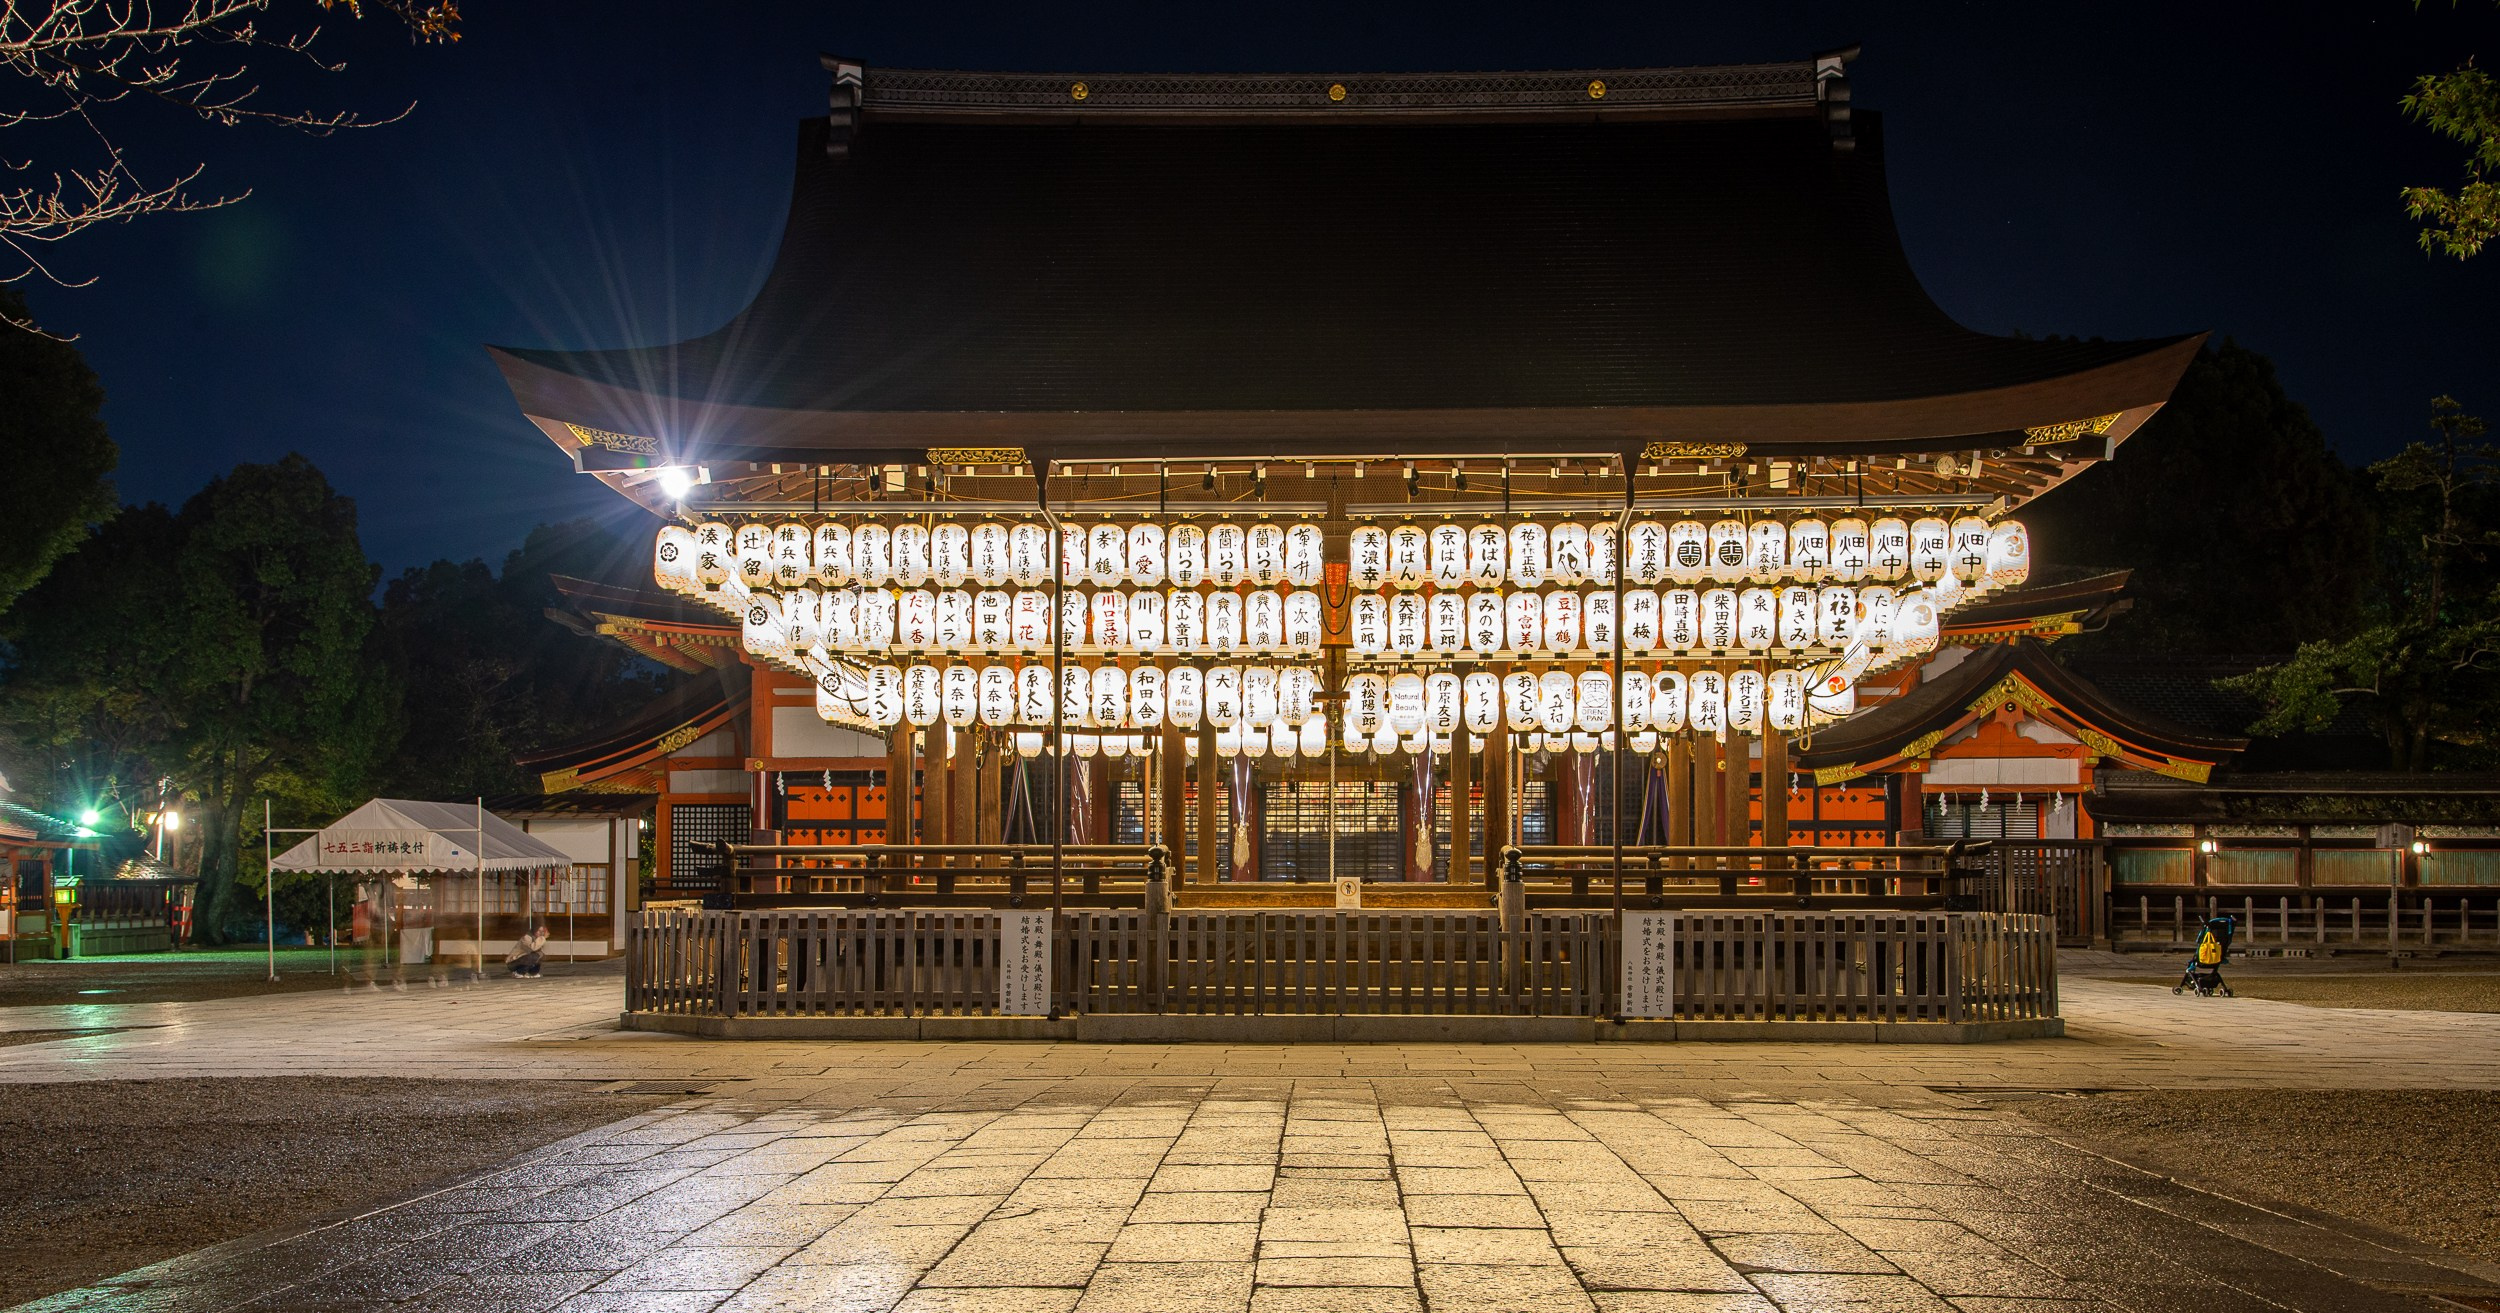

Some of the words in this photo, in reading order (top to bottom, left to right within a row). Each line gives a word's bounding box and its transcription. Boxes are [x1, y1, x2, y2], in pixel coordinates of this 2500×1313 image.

[700, 528, 719, 570] 湊家
[743, 533, 761, 577] 辻留
[779, 527, 797, 579] 権兵衛
[821, 528, 840, 579] 権兵衛
[1135, 531, 1153, 575] 小愛
[1361, 532, 1380, 584] 美濃幸
[1399, 530, 1417, 582] 京ばん
[1439, 529, 1457, 580] 京ばん
[1480, 529, 1499, 579] 京ばん
[1640, 526, 1658, 581] 八木源太郎
[1759, 542, 1770, 575] 美容室
[1770, 539, 1780, 570] アービル
[1798, 536, 1824, 576] 畑中
[1839, 536, 1865, 576] 畑中
[1877, 535, 1904, 575] 畑中
[1920, 538, 1944, 573] 畑中
[1957, 533, 1984, 573] 畑中
[909, 594, 925, 644] だん香
[943, 594, 956, 642] キメラ
[981, 596, 998, 645] 池田家
[1019, 597, 1035, 641] 豆花
[1138, 597, 1153, 641] 川口
[1175, 595, 1191, 648] 茂山童司
[1360, 598, 1376, 647] 矢野一郎
[1398, 598, 1415, 648] 矢野一郎
[1439, 599, 1456, 648] 矢野一郎
[1478, 599, 1496, 645] みの家
[1555, 597, 1572, 644] 豆千鶴
[1593, 599, 1610, 643] 照豊
[1673, 594, 1690, 643] 田崎真也
[1713, 594, 1730, 647] 柴田芳豆
[1751, 595, 1769, 640] 泉政
[1789, 592, 1808, 642] 岡きみ
[875, 669, 889, 720] ミュンヘン
[950, 669, 966, 719] 元奈古
[987, 671, 1002, 720] 元奈古
[1137, 671, 1157, 720] 和田舎
[1179, 672, 1192, 695] 北尾
[1216, 673, 1231, 719] 大晃
[1361, 678, 1377, 728] 小松陽一郎
[1476, 678, 1492, 726] いちえ
[1518, 675, 1534, 725] おくむら
[1738, 675, 1755, 725] 北村クリニック
[1020, 915, 1030, 1010] 結婚式をお受けします
[1034, 915, 1044, 1010] 本殿・舞殿・儀式殿にて
[1641, 917, 1652, 1013] 結婚式をお受けします
[1655, 917, 1666, 1012] 本殿・舞殿・儀式殿にて
